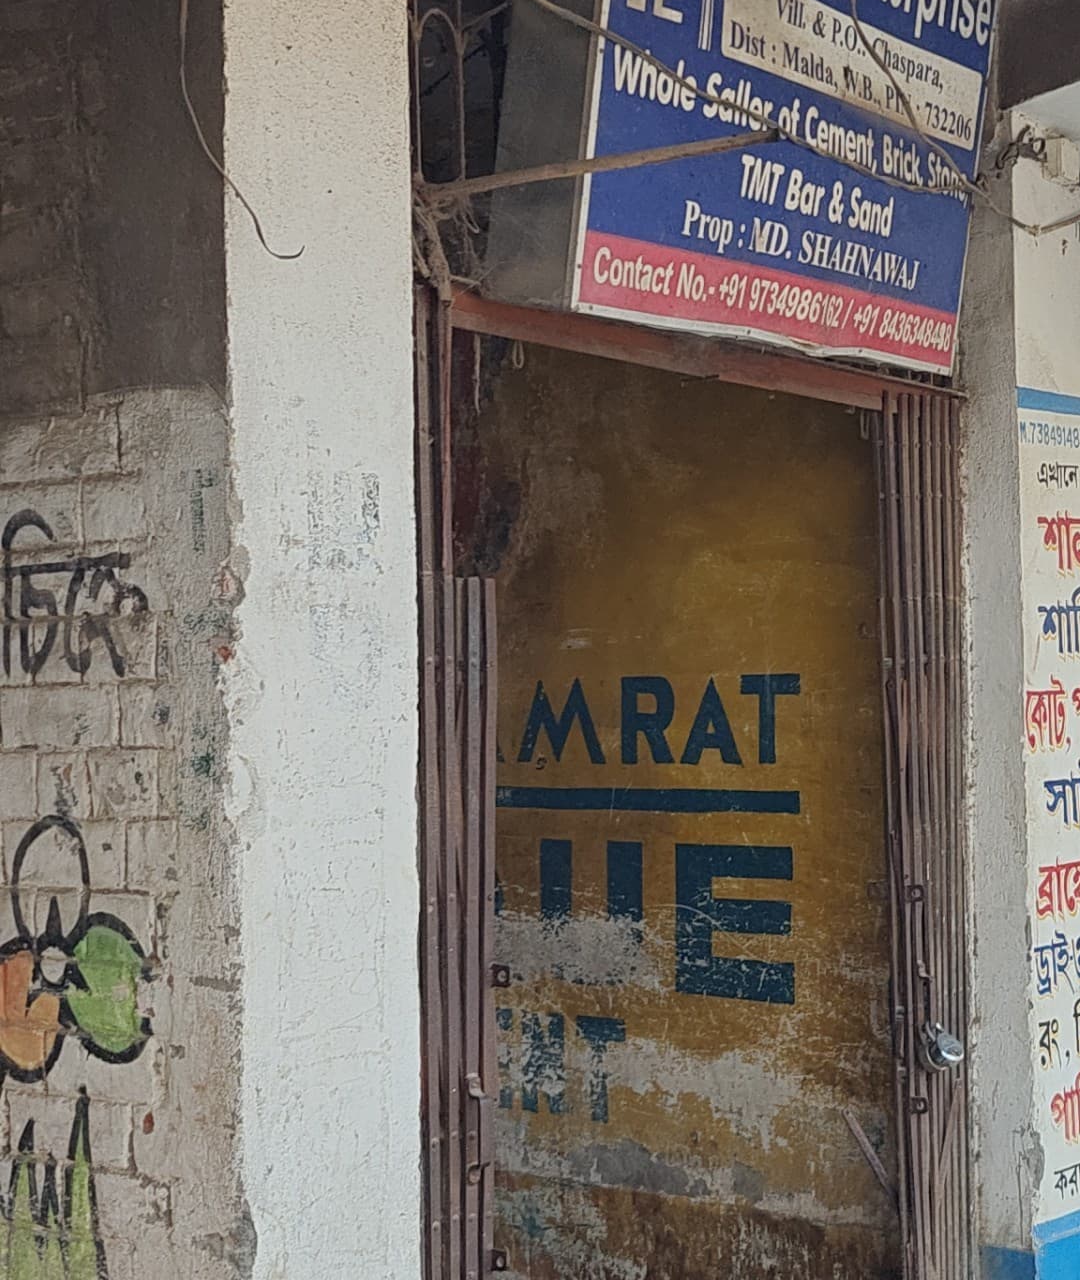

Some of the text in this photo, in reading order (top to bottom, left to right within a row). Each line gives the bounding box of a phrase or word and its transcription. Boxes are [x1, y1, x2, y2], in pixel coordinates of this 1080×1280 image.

[812, 10, 826, 39] &
[614, 44, 697, 112] Whole
[702, 72, 774, 132] Saller
[778, 97, 801, 139] of
[804, 108, 877, 173] Cement,
[729, 20, 766, 62] Dist
[782, 41, 838, 93] Malda,
[924, 101, 973, 141] 732206
[740, 154, 894, 238] TMT Bar & Sand
[681, 200, 734, 254] Prop
[748, 217, 792, 260] MD.
[798, 231, 920, 291] SHAHNAWAJ
[593, 246, 674, 296] Contact
[718, 274, 747, 308] +91
[749, 278, 842, 328] 9734986162
[853, 302, 878, 336] +91
[1037, 461, 1079, 489] এখানে
[495, 673, 801, 766] MRAT
